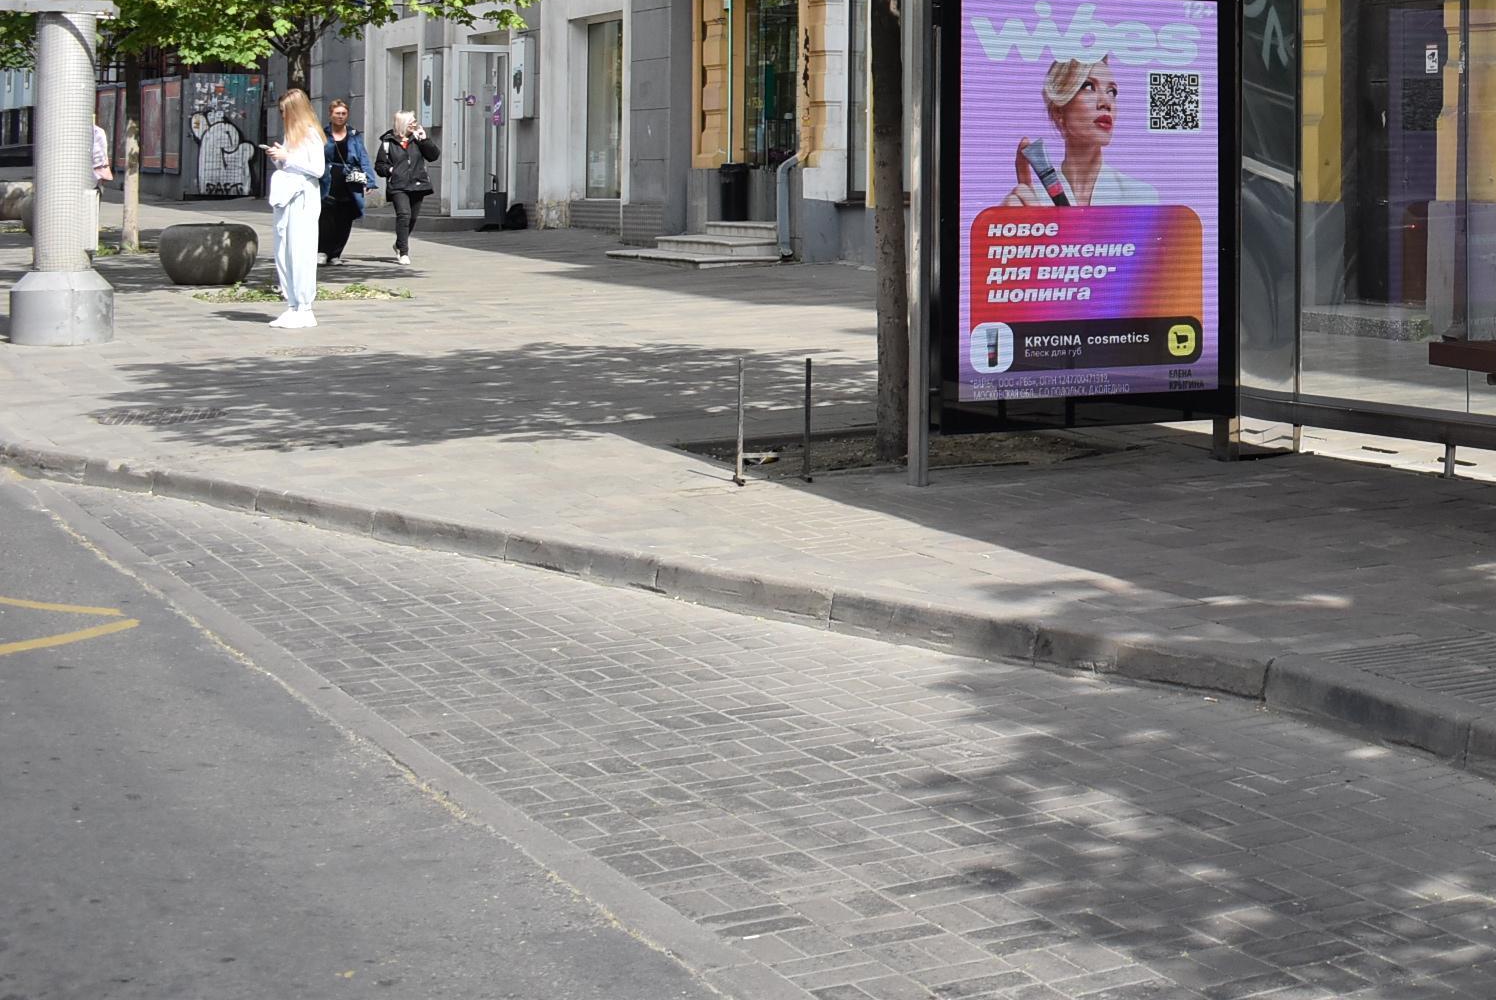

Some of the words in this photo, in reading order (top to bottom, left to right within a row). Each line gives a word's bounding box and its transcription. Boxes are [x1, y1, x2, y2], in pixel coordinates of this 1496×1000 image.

[987, 222, 1059, 237] новое
[987, 243, 1136, 264] приложение
[986, 265, 1031, 284] для
[1037, 264, 1117, 282] видео-
[987, 286, 1091, 303] шопинга
[1025, 334, 1082, 347] KRYGINA
[1087, 332, 1150, 345] cosmetics
[1025, 348, 1049, 358] Блеск
[1051, 348, 1066, 357] для
[1068, 346, 1082, 357] губ
